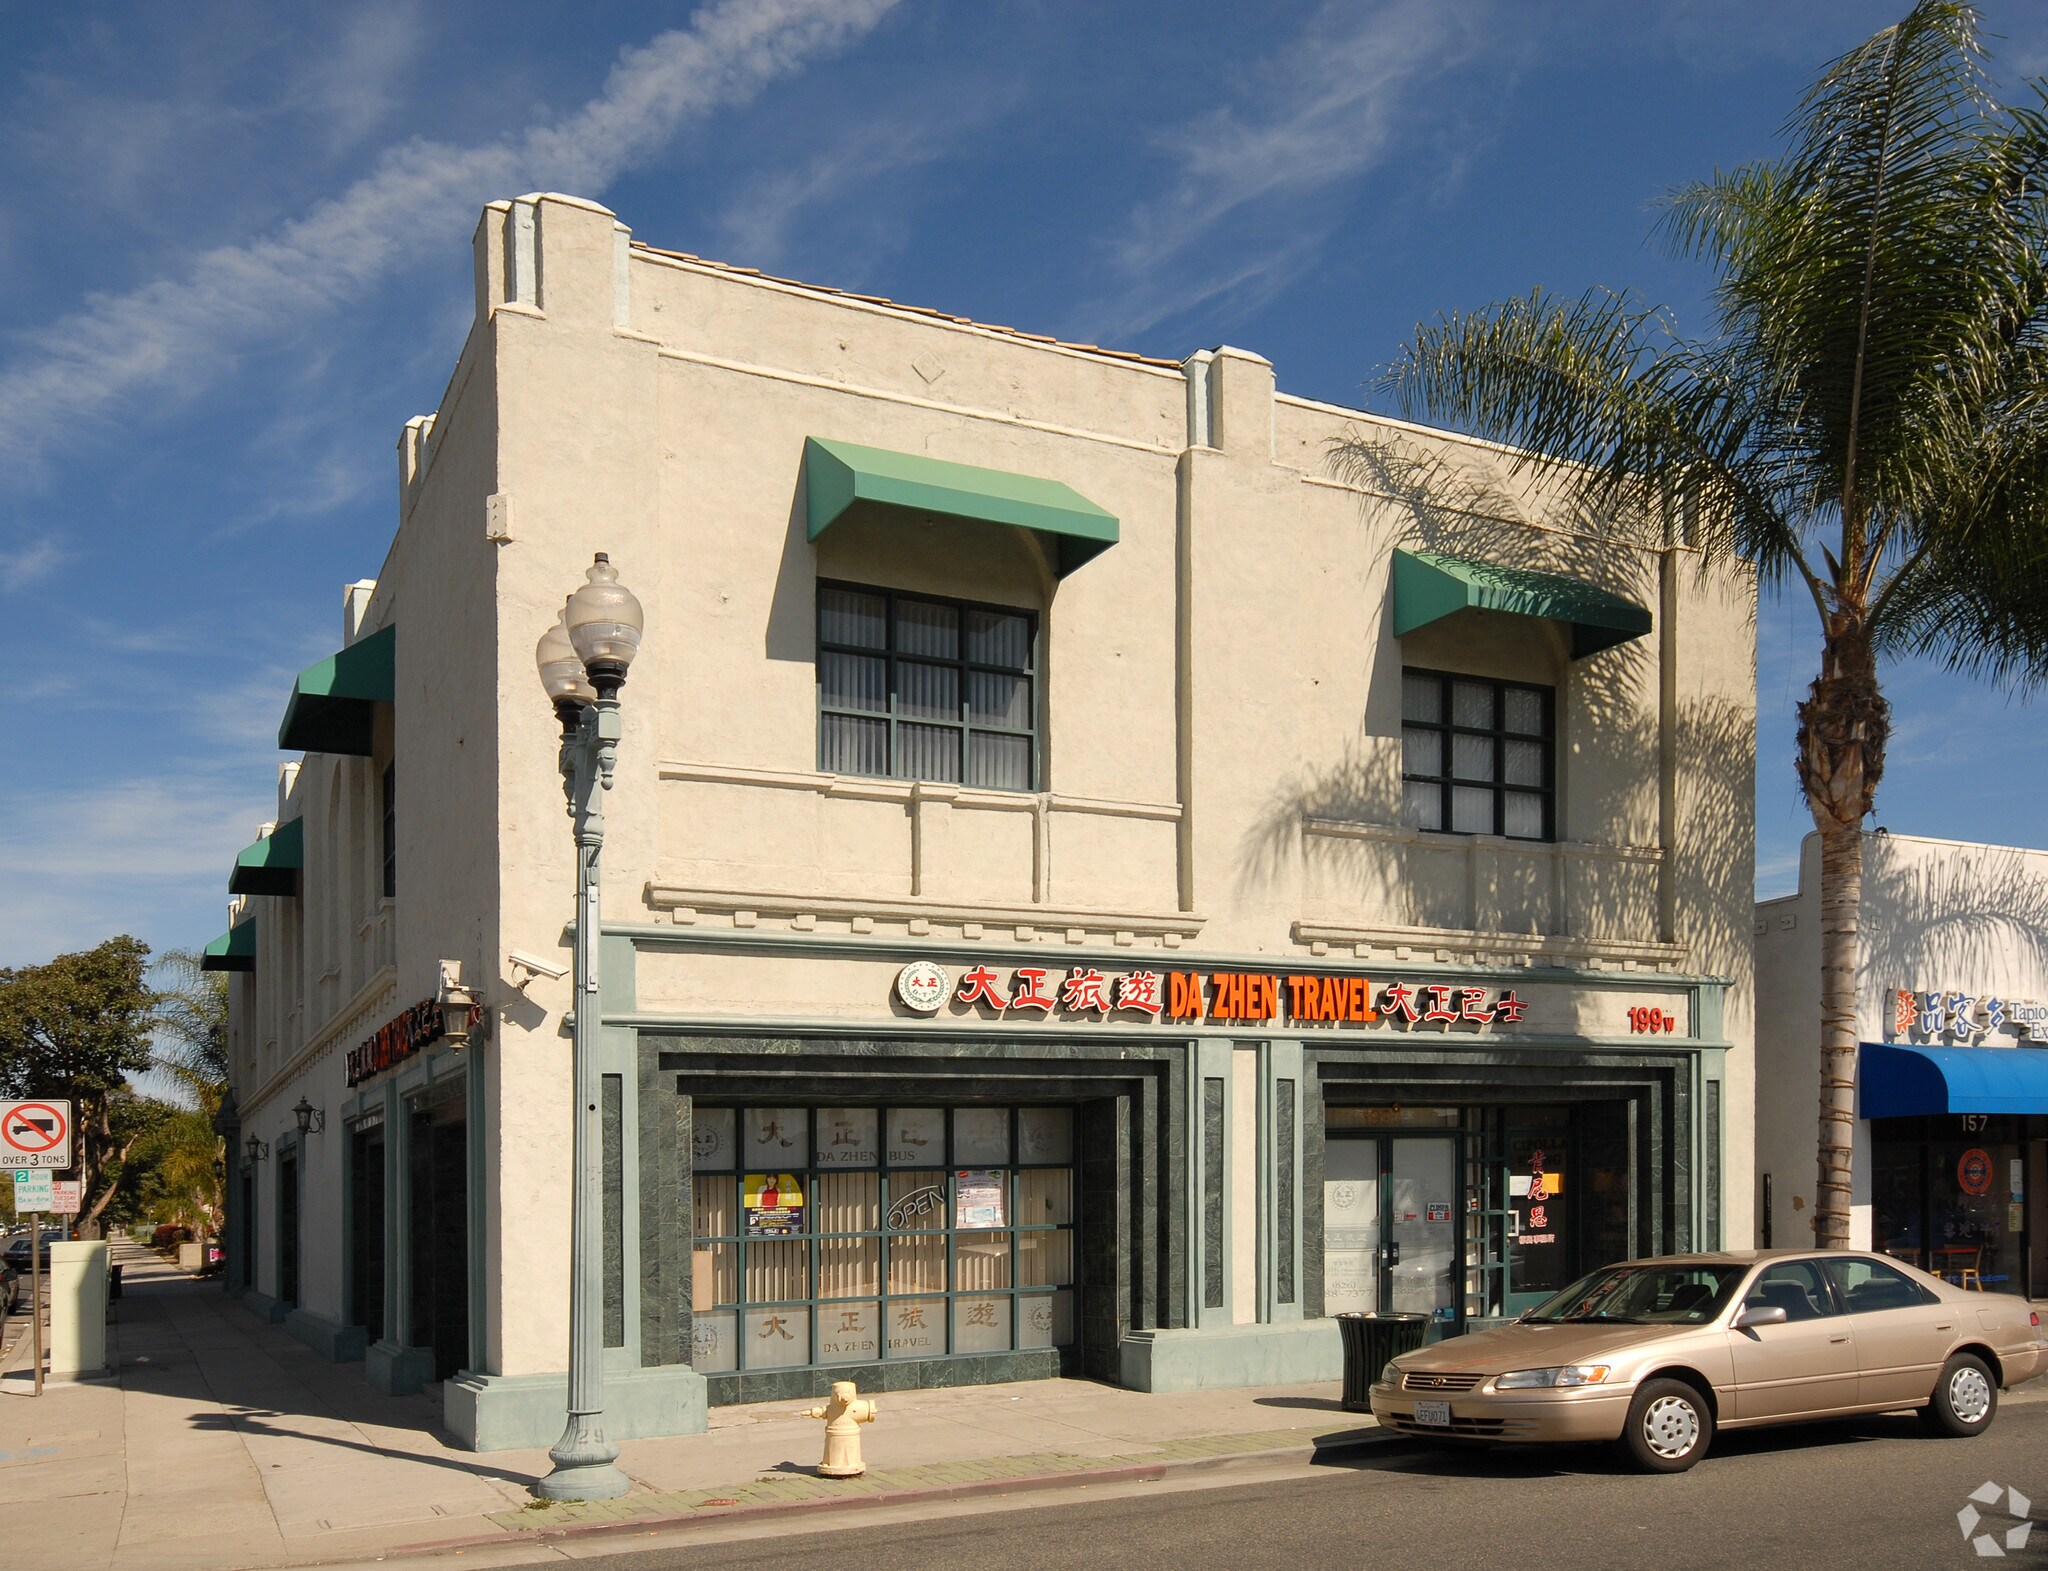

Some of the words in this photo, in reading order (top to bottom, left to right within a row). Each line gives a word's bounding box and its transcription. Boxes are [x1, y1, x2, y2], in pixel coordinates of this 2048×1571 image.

[911, 976, 938, 988] 大正
[957, 965, 1164, 1015] 大正旅遊
[1169, 971, 1202, 1018] DA
[1213, 973, 1277, 1019] ZHEN
[1287, 976, 1377, 1022] TRAVEL
[1381, 981, 1529, 1024] 大正巴士
[1921, 991, 2005, 1037] 品客多
[1962, 1115, 1988, 1131] 157
[3, 1156, 27, 1164] OVER
[30, 1154, 38, 1166] 3
[42, 1155, 65, 1164] TONS
[817, 1152, 835, 1162] DA
[840, 1151, 878, 1162] ZHEN
[888, 1151, 915, 1161] BUS
[16, 1171, 28, 1182] 2
[18, 1185, 49, 1193] PARKING
[888, 1185, 945, 1231] OPEN
[1429, 1204, 1449, 1212] CLOSED
[823, 1343, 839, 1353] DA
[845, 1340, 876, 1351] ZHEN
